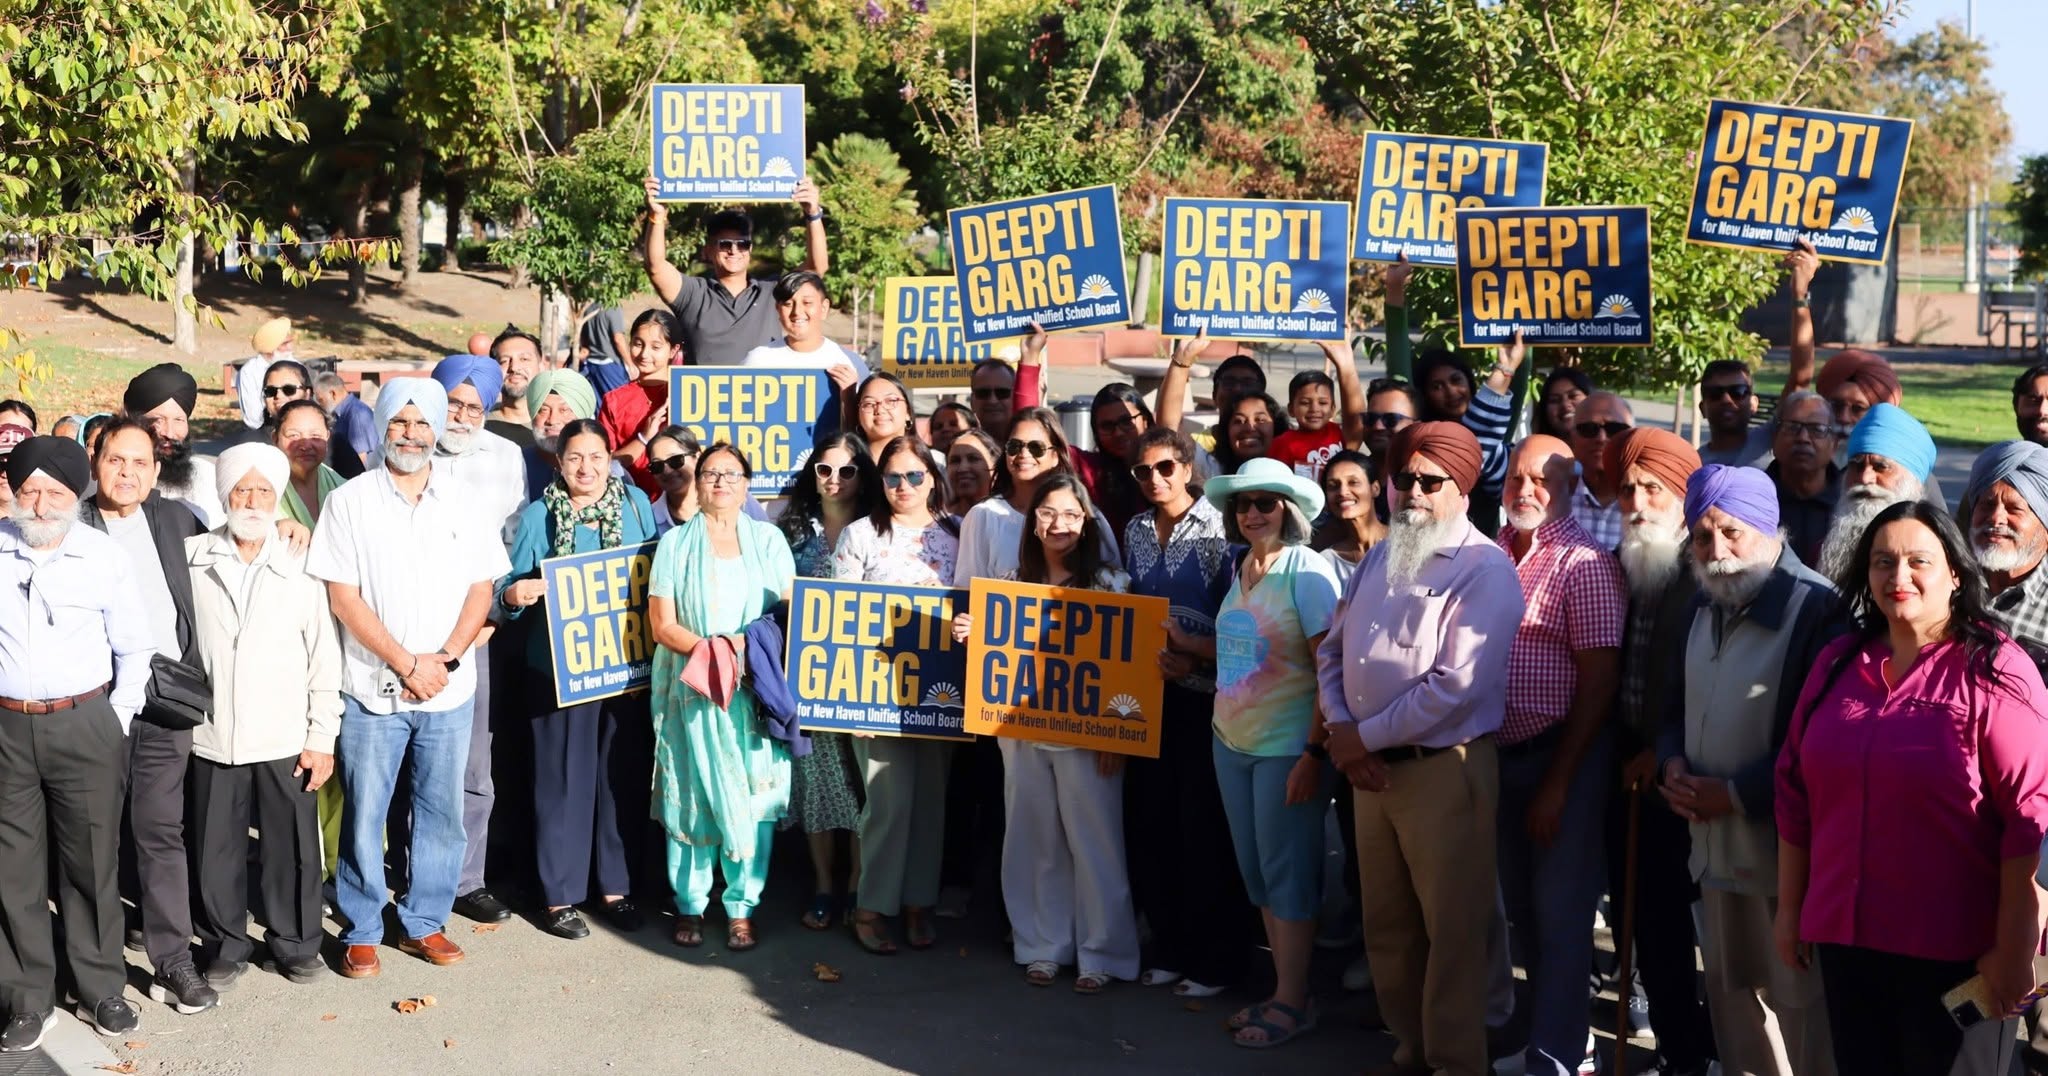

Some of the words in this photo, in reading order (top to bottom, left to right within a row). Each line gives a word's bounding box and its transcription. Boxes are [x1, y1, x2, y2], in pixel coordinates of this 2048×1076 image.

[662, 91, 782, 134] DEEPTI
[662, 135, 760, 179] GARG
[1372, 140, 1519, 197] DEEPTI
[1714, 109, 1880, 179] DEEPTI
[663, 180, 676, 192] for
[676, 181, 694, 192] New
[694, 181, 719, 192] Haven
[719, 180, 747, 192] Unified
[748, 180, 774, 192] School
[1705, 164, 1837, 230] GARG
[960, 197, 1095, 266] DEEPTI
[1176, 206, 1322, 260] DEEPTI
[1367, 189, 1486, 242] GAR
[1701, 218, 1716, 233] for
[1718, 220, 1740, 237] New
[1741, 223, 1773, 240] Haven
[1812, 231, 1846, 249] School
[1847, 235, 1878, 253] Board
[1366, 238, 1380, 252] for
[1403, 241, 1431, 256] Haven
[1433, 244, 1457, 258] Unifi
[1467, 216, 1621, 268] DEEPTI
[898, 286, 959, 324] DEE
[968, 254, 1076, 317] GARG
[1174, 259, 1292, 313] GARG
[1471, 269, 1593, 320] GARG
[973, 319, 986, 333] for
[988, 317, 1005, 331] New
[1007, 315, 1033, 329] Haven
[1034, 308, 1064, 324] Unified
[1065, 303, 1094, 320] School
[1095, 299, 1121, 316] Board
[1173, 312, 1188, 327] for
[1189, 313, 1209, 328] New
[1211, 314, 1240, 329] Haven
[1242, 315, 1275, 330] Unified
[1276, 316, 1307, 331] School
[1309, 318, 1337, 332] Board
[1473, 322, 1488, 336] for
[1489, 323, 1510, 336] New
[1543, 322, 1578, 336] Unified
[1580, 322, 1611, 336] School
[1613, 322, 1642, 336] Board
[908, 368, 925, 378] New
[926, 367, 950, 378] Haven
[951, 367, 974, 378] Unifie
[681, 375, 817, 423] DEEPTI
[750, 474, 776, 488] nified
[776, 474, 798, 488] Scho
[555, 553, 653, 620] DEEP
[801, 588, 953, 651] DEEPTI
[984, 592, 1134, 663] DEEPTI
[568, 678, 582, 693] for
[583, 675, 602, 690] New
[603, 670, 629, 686] Haven
[629, 663, 651, 679] Unifie
[798, 645, 920, 706] GARG
[982, 650, 1101, 717] GARG
[797, 702, 811, 717] for
[813, 704, 833, 719] New
[836, 706, 865, 721] Haven
[867, 708, 901, 724] Unified
[903, 710, 936, 726] School
[980, 706, 994, 721] for
[996, 709, 1016, 724] New
[1018, 711, 1046, 729] Haven
[1049, 715, 1082, 733] Unified
[1084, 720, 1116, 738] School
[1119, 724, 1147, 743] Board
